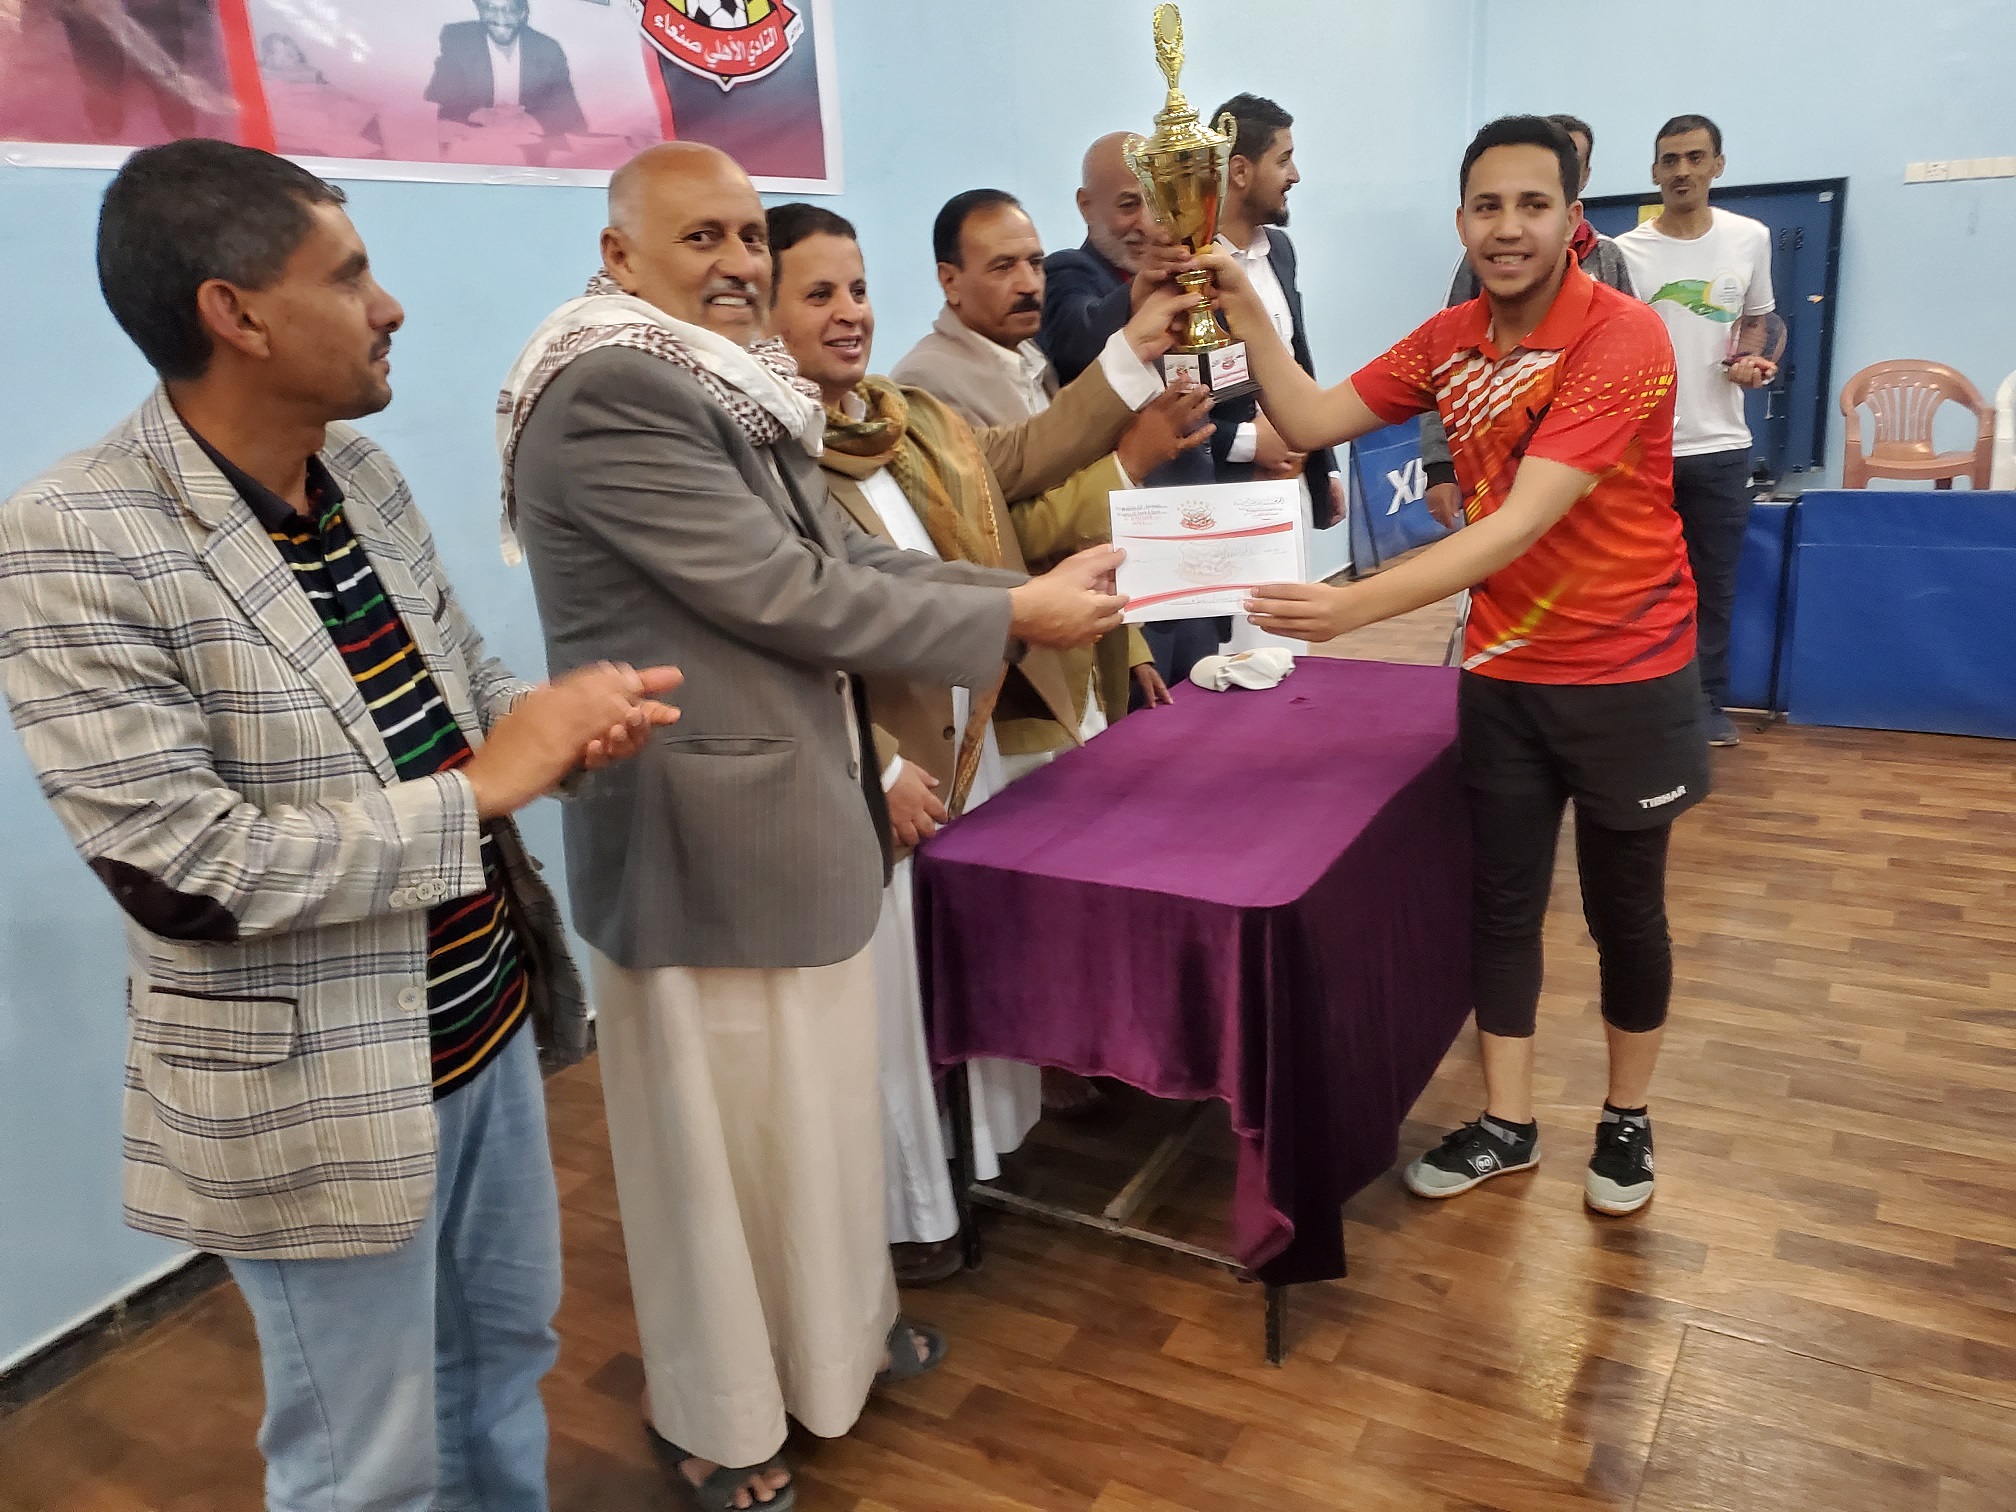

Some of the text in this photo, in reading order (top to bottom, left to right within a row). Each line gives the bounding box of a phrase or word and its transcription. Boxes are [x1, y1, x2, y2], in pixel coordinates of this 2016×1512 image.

[653, 13, 703, 54] صنعاء
[704, 35, 746, 69] الأهلي
[747, 26, 779, 67] النادي
[1385, 457, 1429, 516] XI
[1638, 785, 1688, 809] TIBHAR
